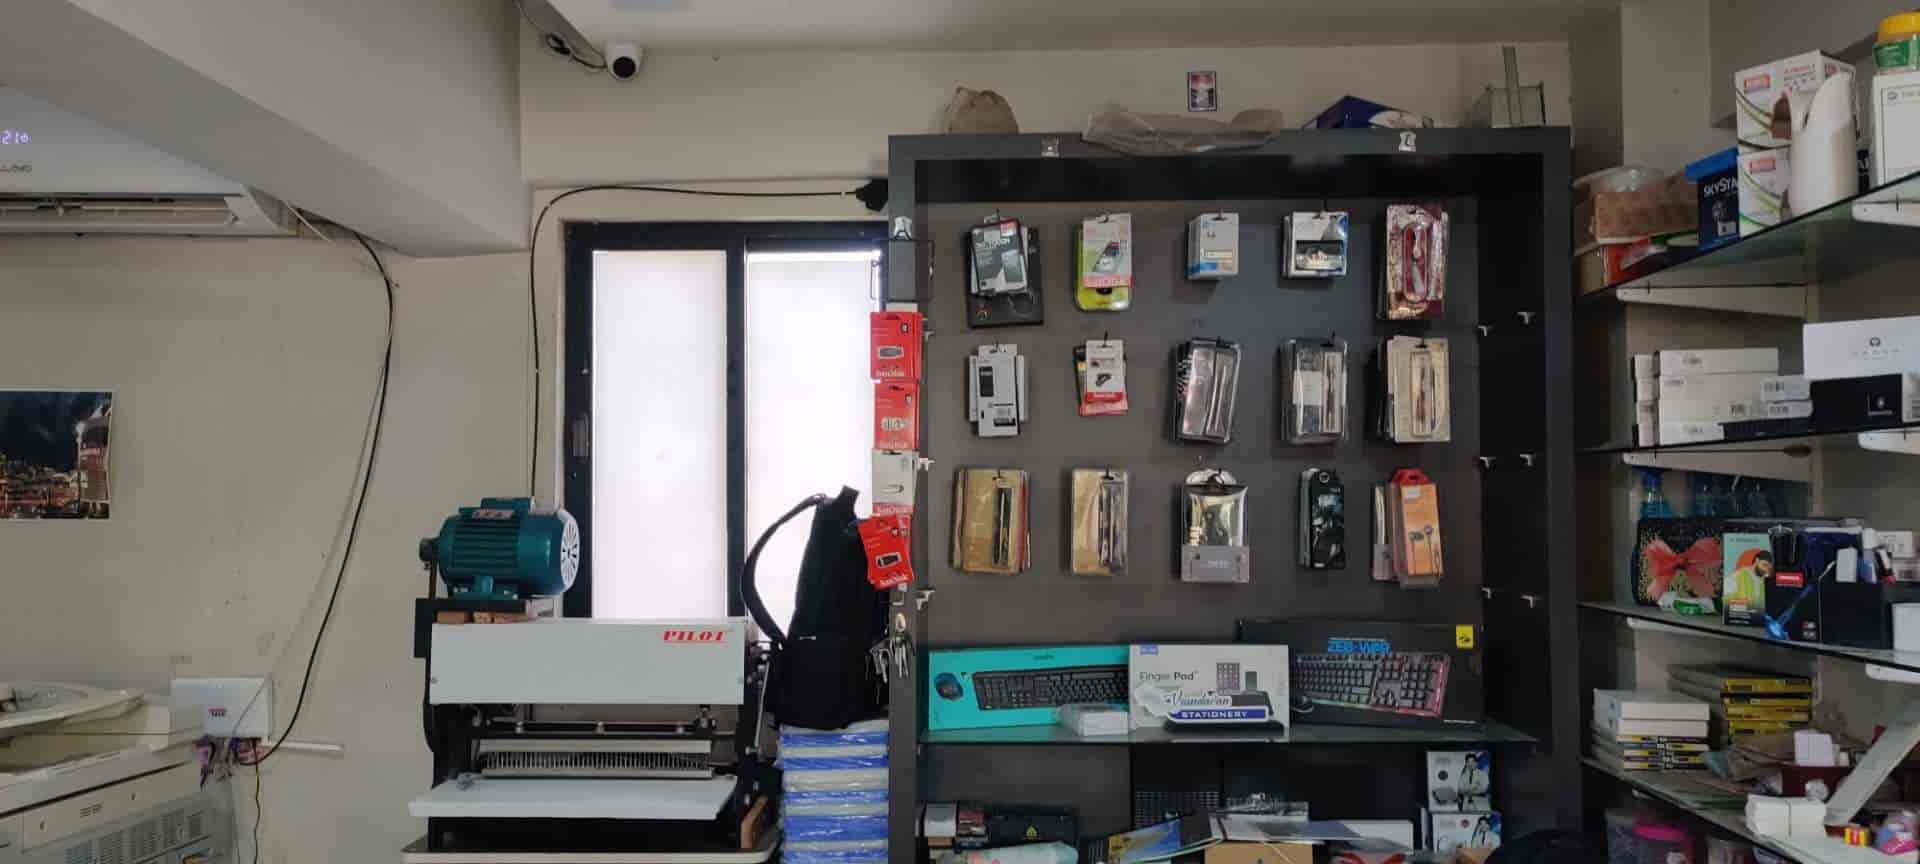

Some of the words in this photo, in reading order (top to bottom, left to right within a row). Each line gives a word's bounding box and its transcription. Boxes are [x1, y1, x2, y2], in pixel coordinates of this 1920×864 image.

[663, 630, 733, 641] PILOT
[1173, 671, 1195, 681] Pad
[1181, 710, 1249, 719] STATIONERY
